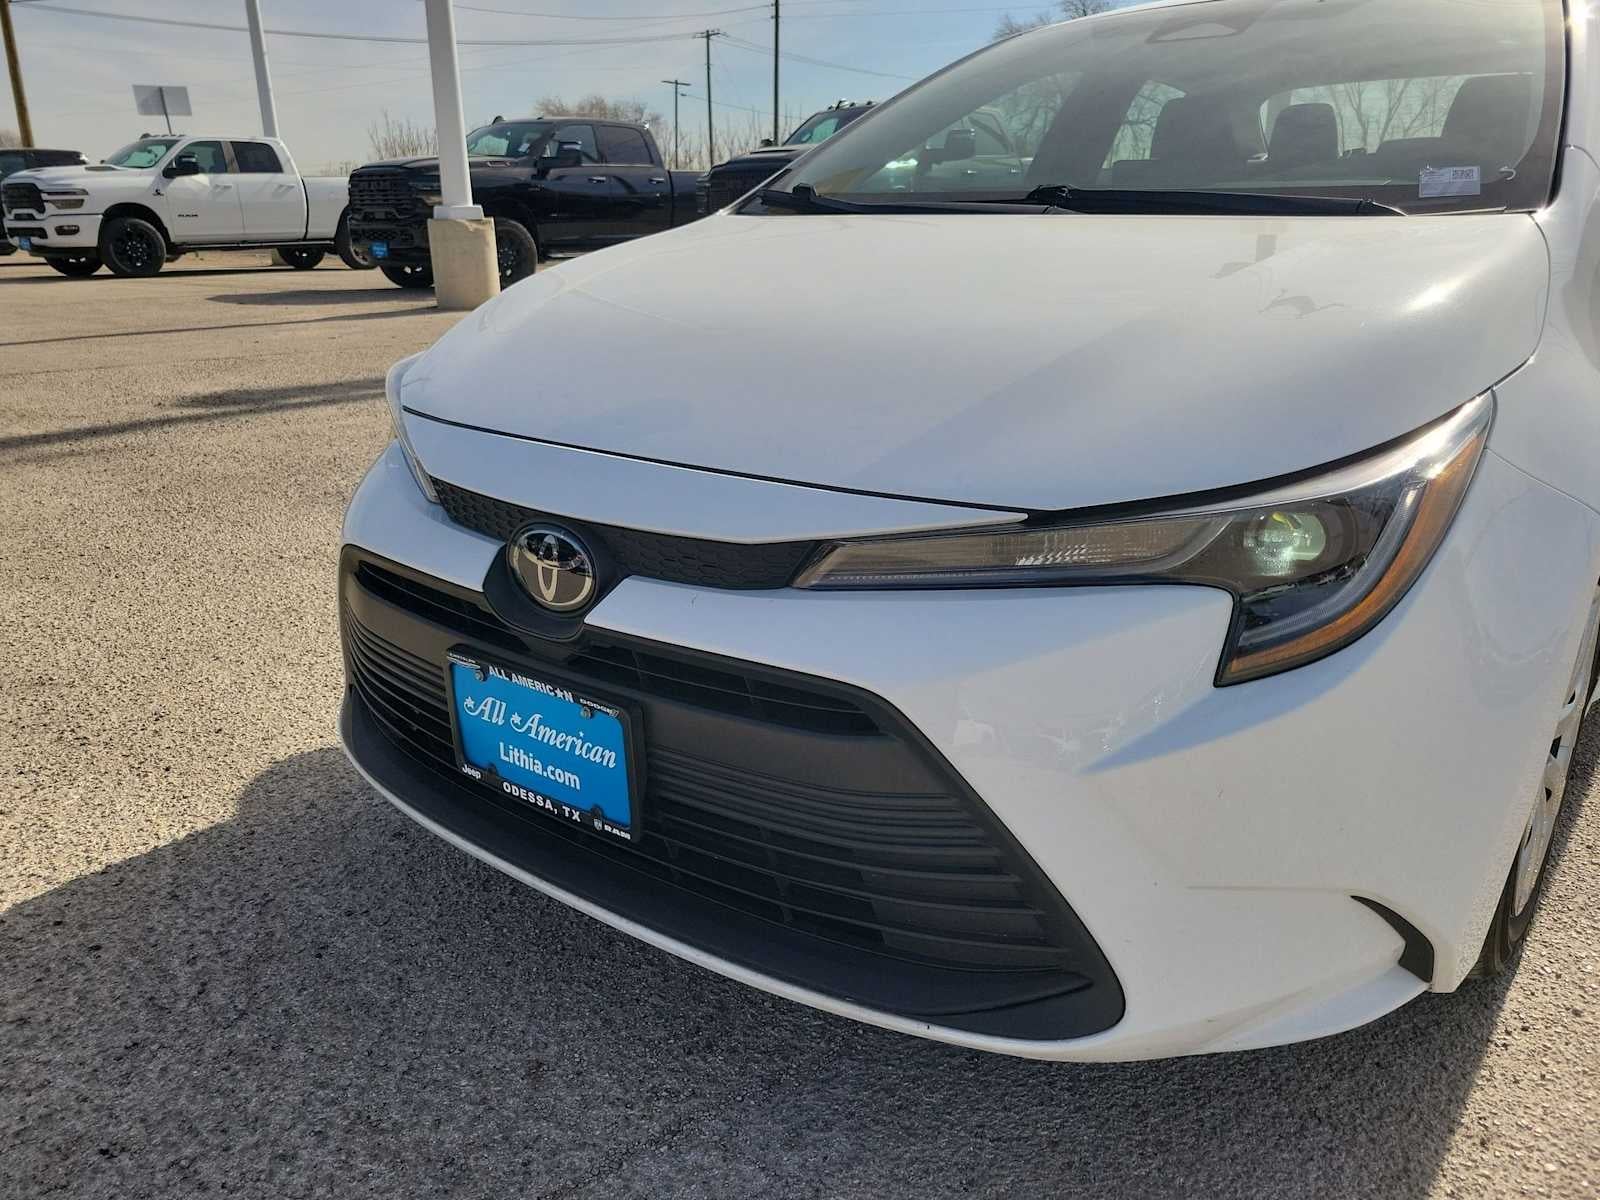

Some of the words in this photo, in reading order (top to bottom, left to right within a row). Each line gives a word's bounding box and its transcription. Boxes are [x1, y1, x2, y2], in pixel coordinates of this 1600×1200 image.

[488, 665, 510, 681] ALL
[463, 696, 507, 726] All
[510, 712, 617, 769] American
[462, 764, 482, 780] Jeep
[499, 741, 581, 790] Lithia.com
[502, 781, 558, 815] ODESSA,
[562, 805, 581, 822] TX
